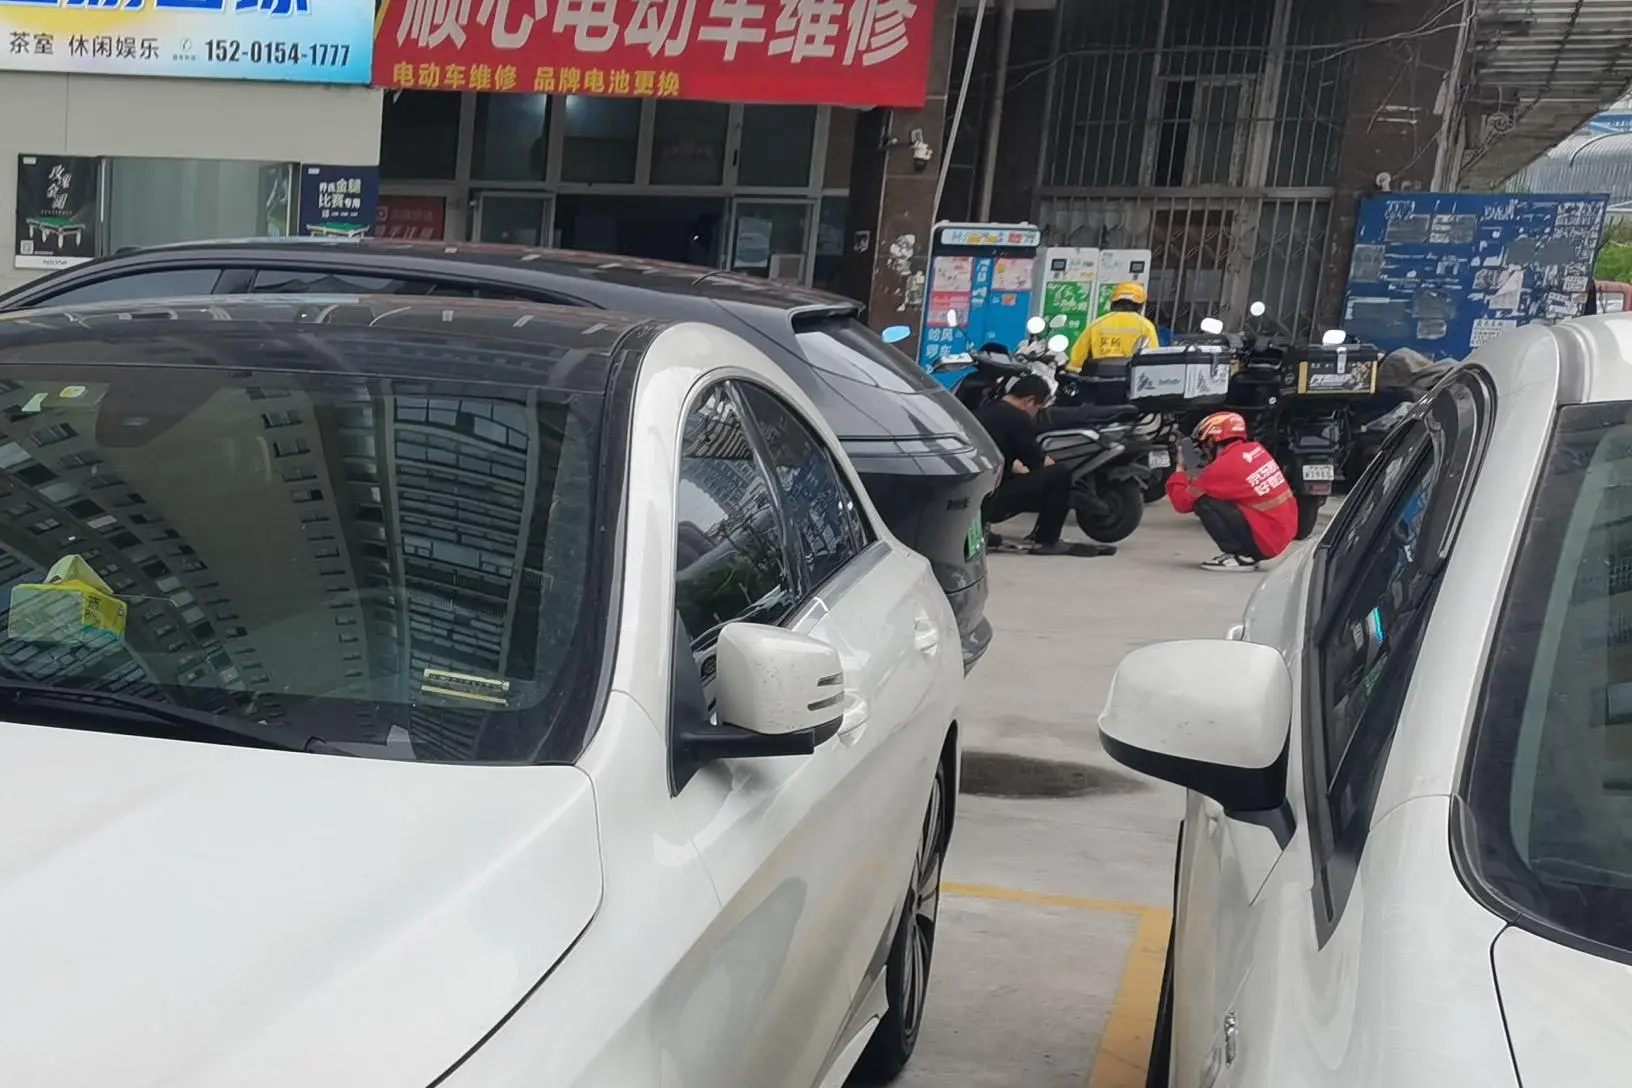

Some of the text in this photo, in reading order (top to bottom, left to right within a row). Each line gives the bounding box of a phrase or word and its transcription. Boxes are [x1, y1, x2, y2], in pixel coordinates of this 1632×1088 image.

[9, 31, 54, 55] 茶室
[68, 34, 159, 60] 休闲娱乐
[396, 0, 917, 66] 顺心电动车维修
[205, 39, 351, 67] 152-0154-1777
[393, 61, 680, 97] 电动车维修 品牌电池更换
